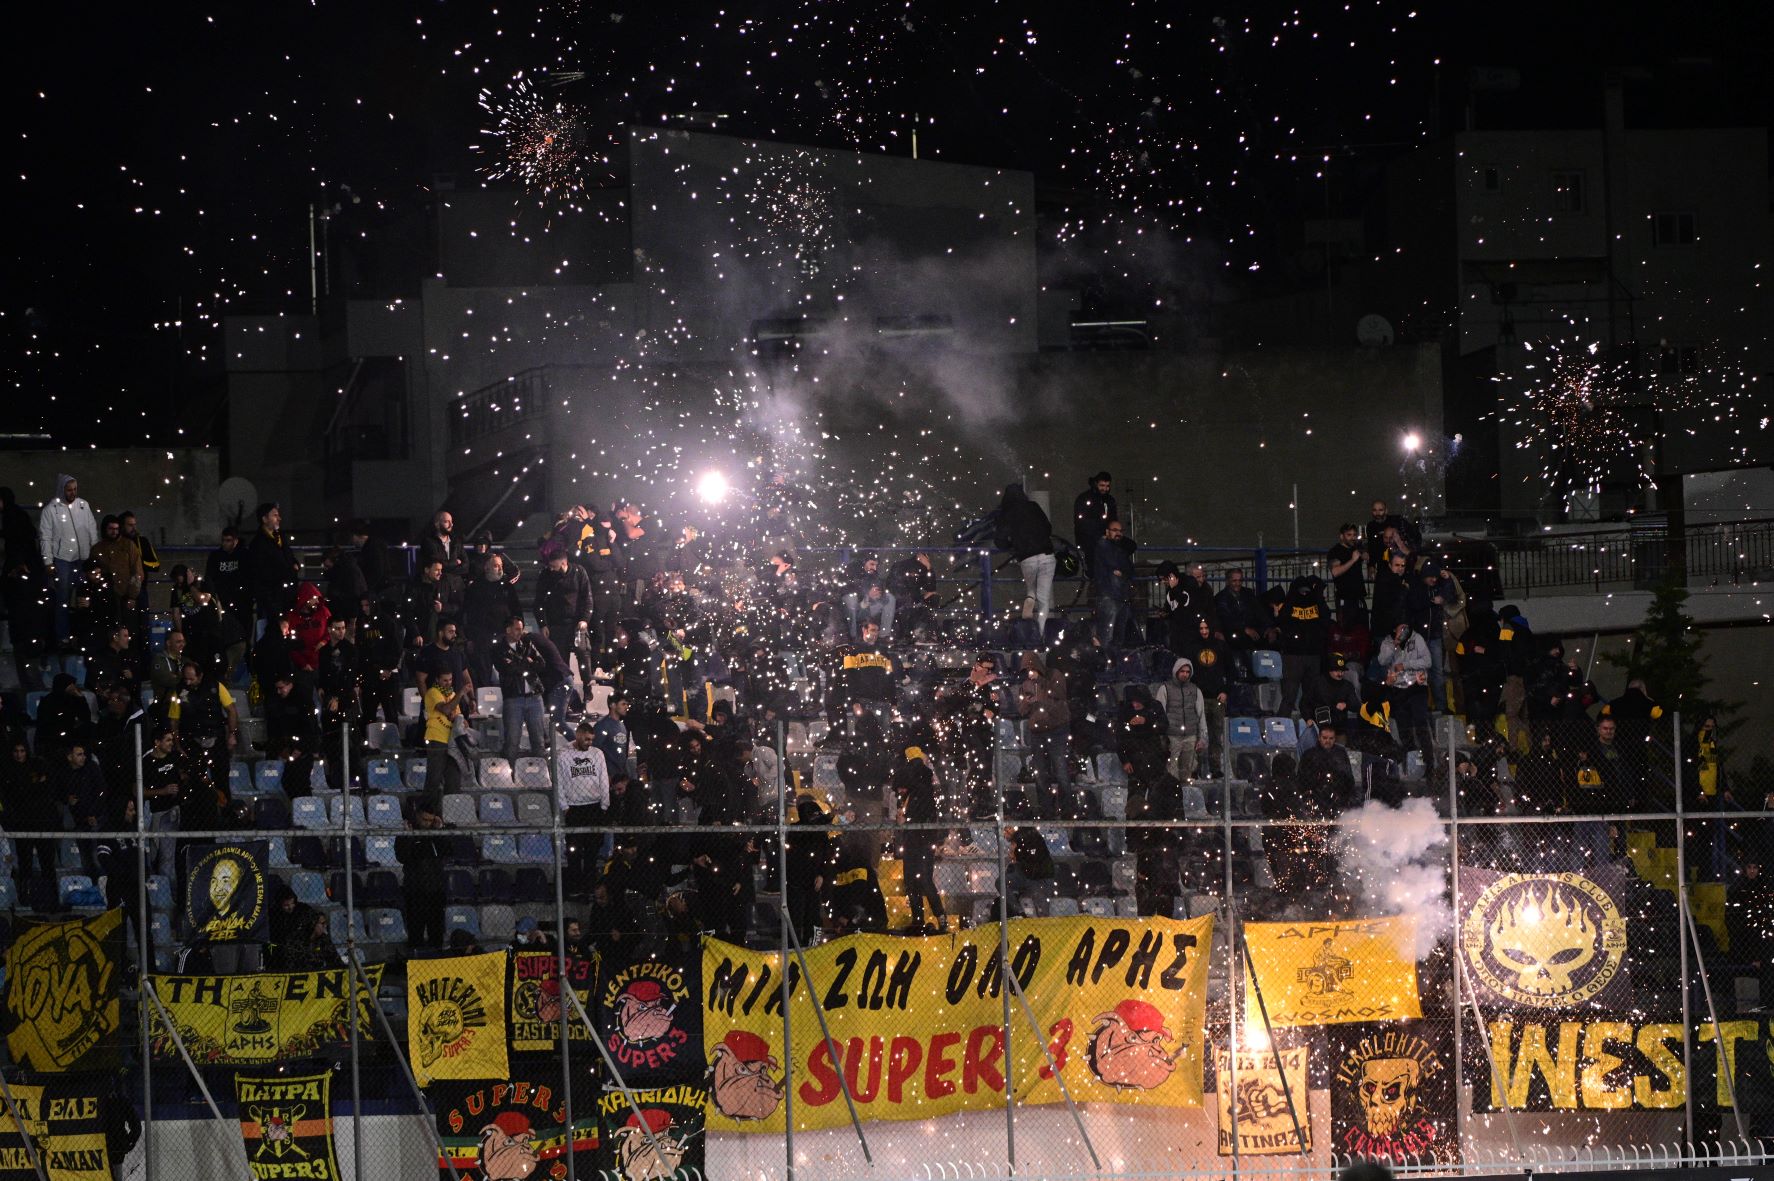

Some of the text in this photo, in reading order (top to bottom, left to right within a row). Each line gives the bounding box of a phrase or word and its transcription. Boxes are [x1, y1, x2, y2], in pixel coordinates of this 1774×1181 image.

[1066, 926, 1197, 991] ΑΡΗΣ
[515, 1023, 593, 1041] EAST BOCK
[799, 1017, 1073, 1106] SUPER 3
[1488, 1020, 1759, 1109] WEST
[449, 1082, 552, 1133] SUPER
